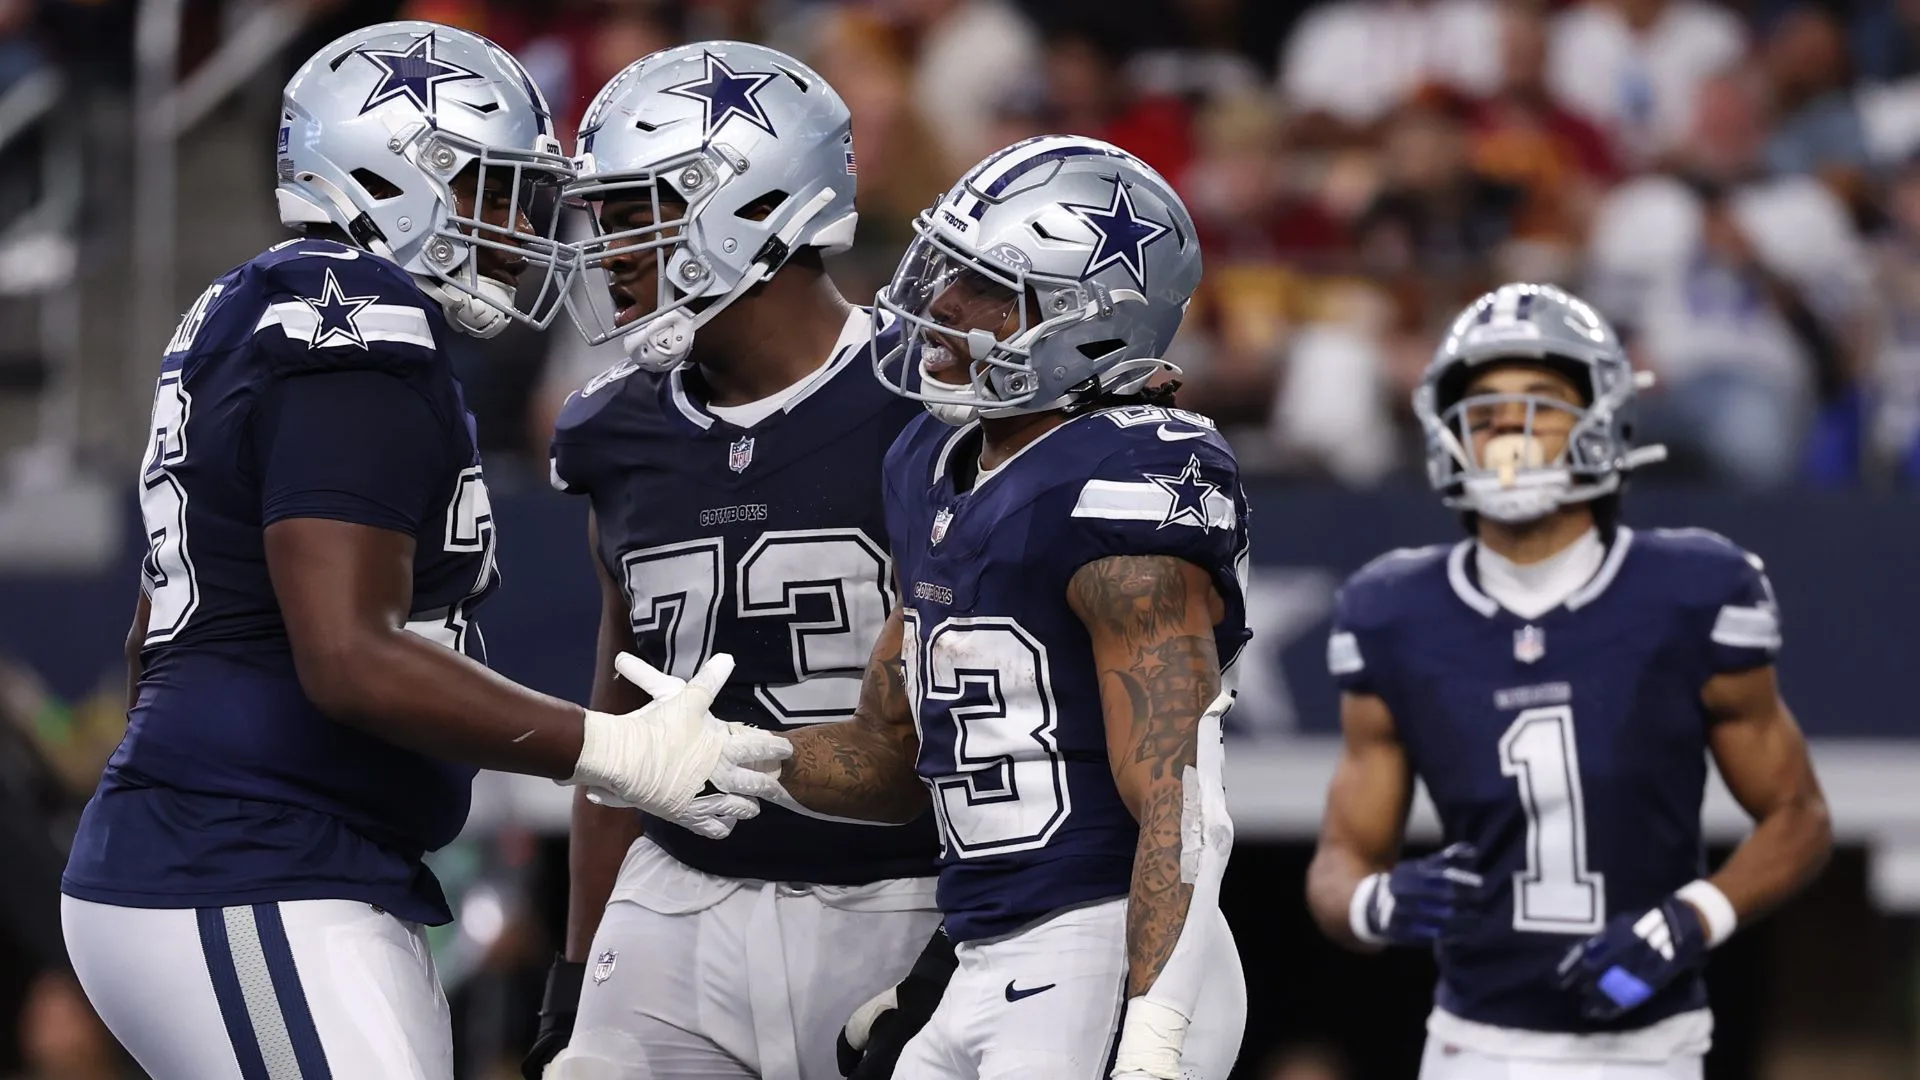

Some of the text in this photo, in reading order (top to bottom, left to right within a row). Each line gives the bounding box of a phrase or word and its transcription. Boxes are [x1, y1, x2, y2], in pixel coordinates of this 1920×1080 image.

[941, 209, 969, 233] WBOYS
[700, 503, 768, 527] COWBOYS
[621, 527, 898, 726] 73
[914, 581, 953, 606] COWBOYS
[901, 607, 1072, 860] 3
[1498, 703, 1605, 935] 1
